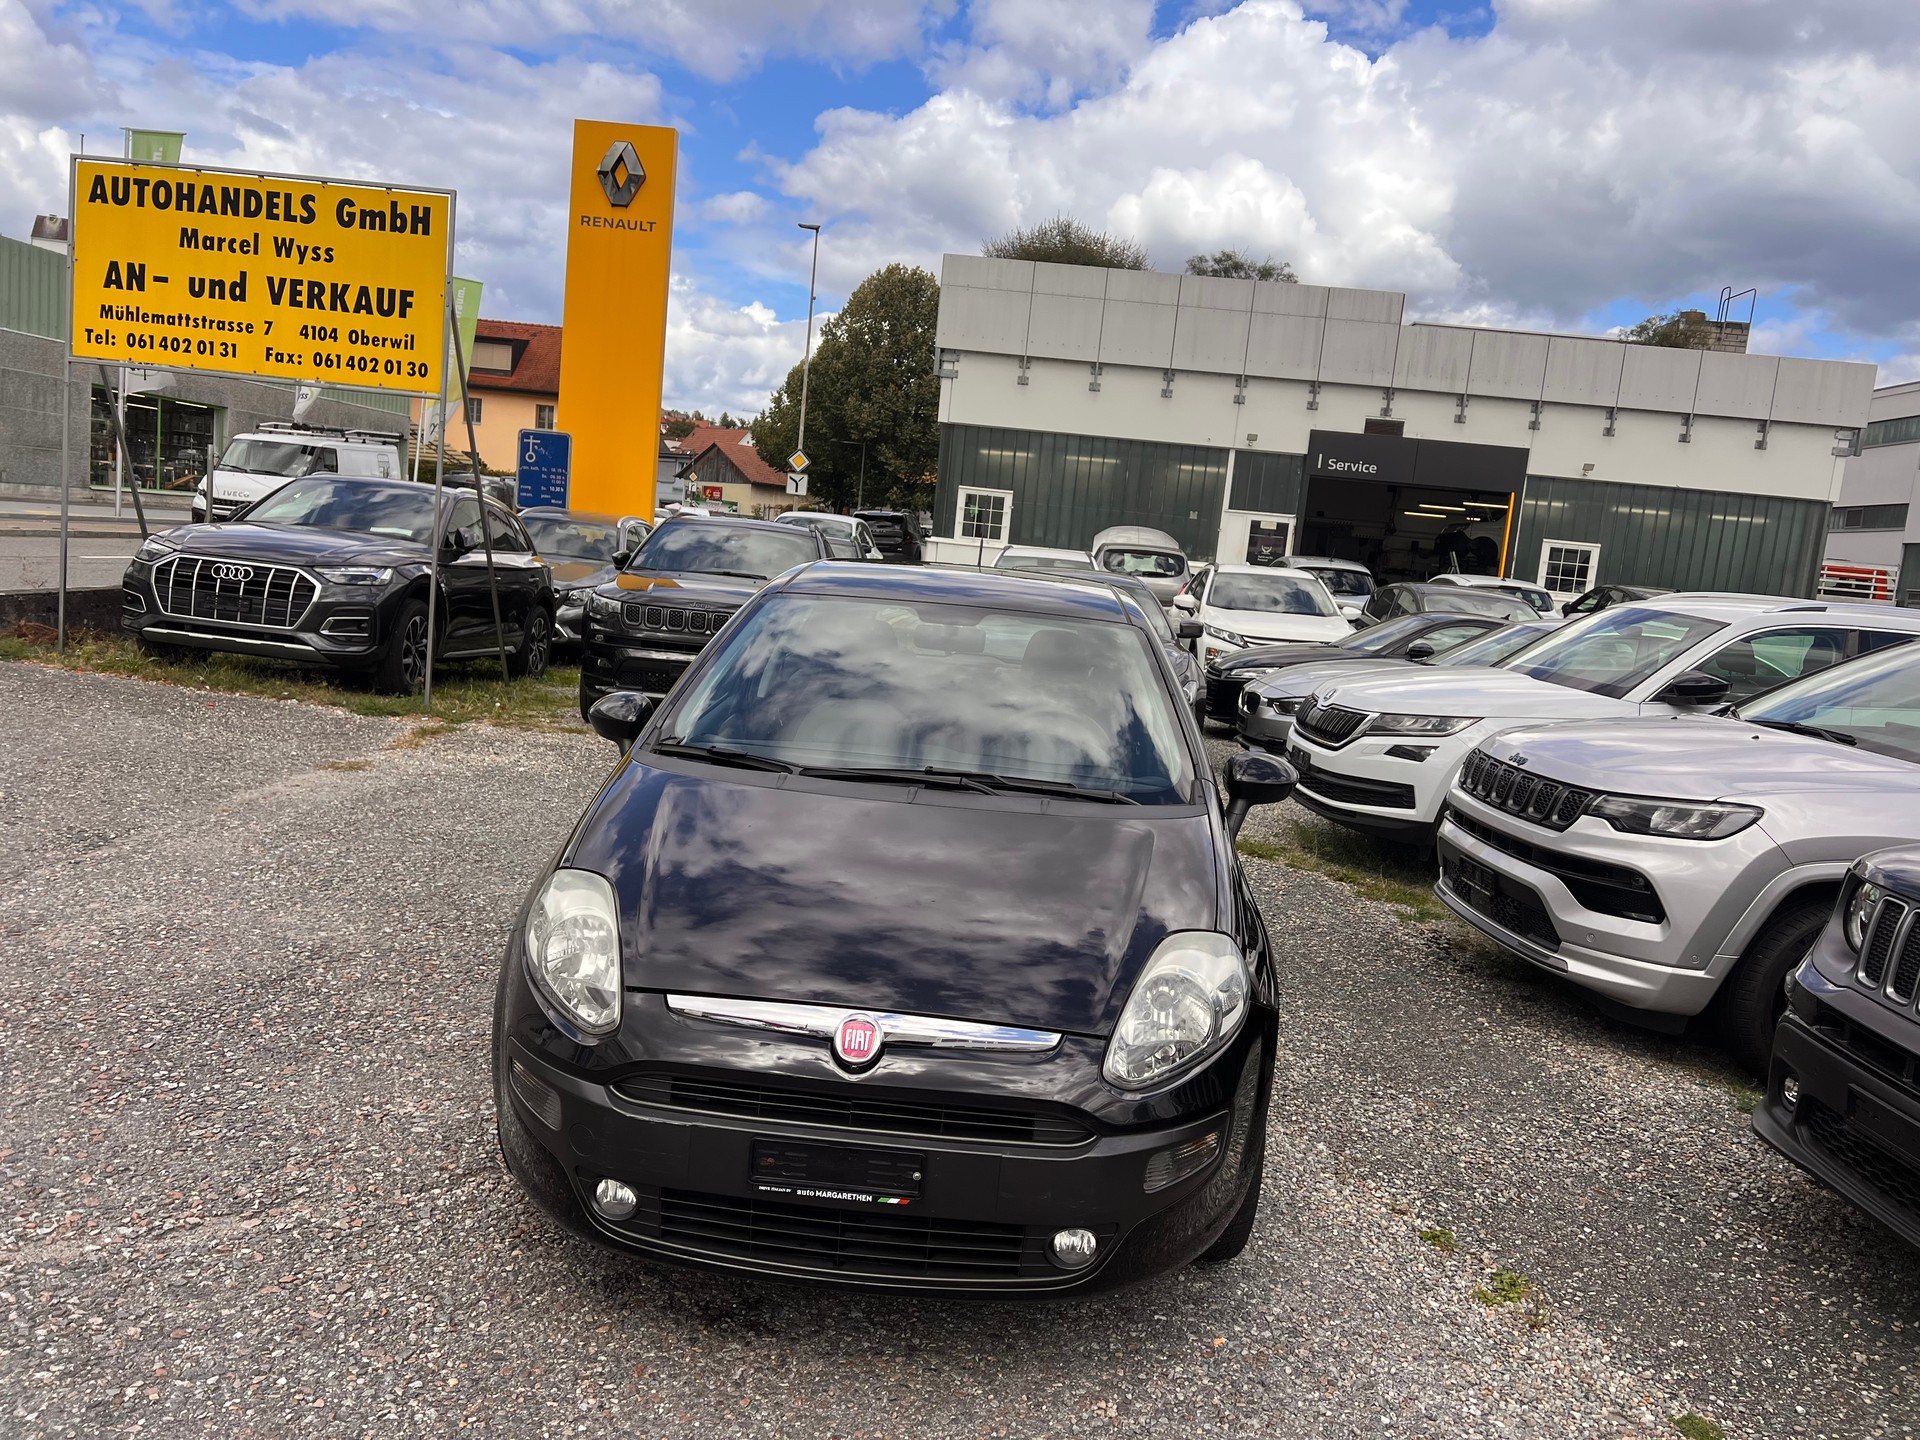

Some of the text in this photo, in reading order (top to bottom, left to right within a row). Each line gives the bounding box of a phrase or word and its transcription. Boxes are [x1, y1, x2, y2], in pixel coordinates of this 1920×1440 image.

[89, 174, 431, 236] AUTOHANDELS GmbH
[580, 215, 656, 232] RENAULT
[179, 227, 334, 265] Marcel Wyss
[188, 271, 247, 303] und
[266, 275, 414, 319] VERKAUF
[99, 304, 415, 351] Mühlemattstrasse 7 4104 Oberwil
[85, 328, 117, 347] Tel:
[265, 346, 303, 366] Fax:
[1327, 458, 1378, 474] Service
[222, 490, 250, 498] IVECO
[1508, 752, 1529, 766] Jeep
[844, 1028, 873, 1051] FIAT
[816, 1190, 872, 1202] MARGARETHEN
